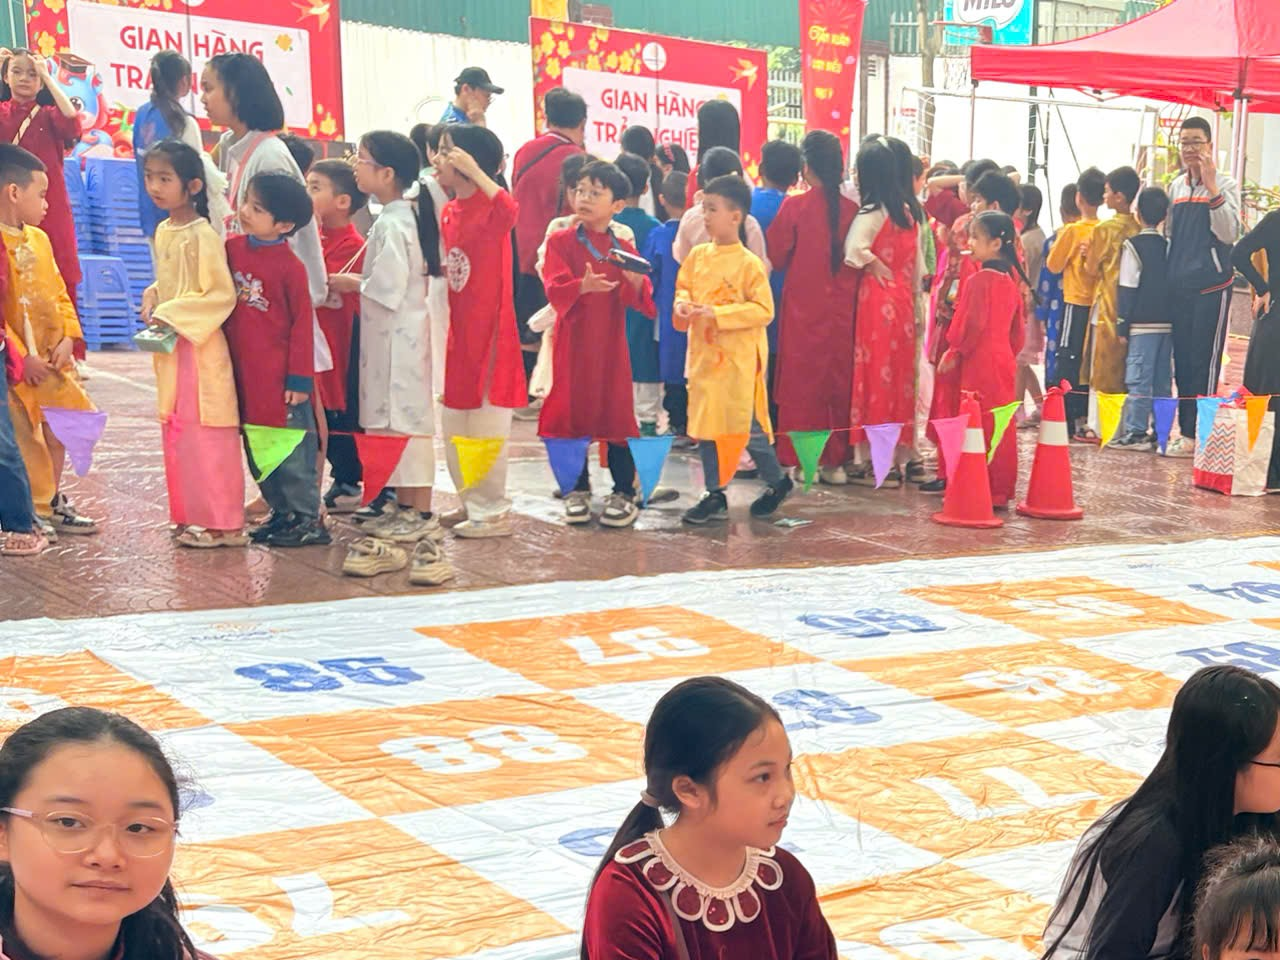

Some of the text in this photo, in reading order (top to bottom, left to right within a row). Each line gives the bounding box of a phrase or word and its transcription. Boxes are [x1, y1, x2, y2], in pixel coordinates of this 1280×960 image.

[119, 25, 264, 63] GIAN HÀNG
[601, 88, 647, 112] GIAN
[378, 725, 588, 775] 88
